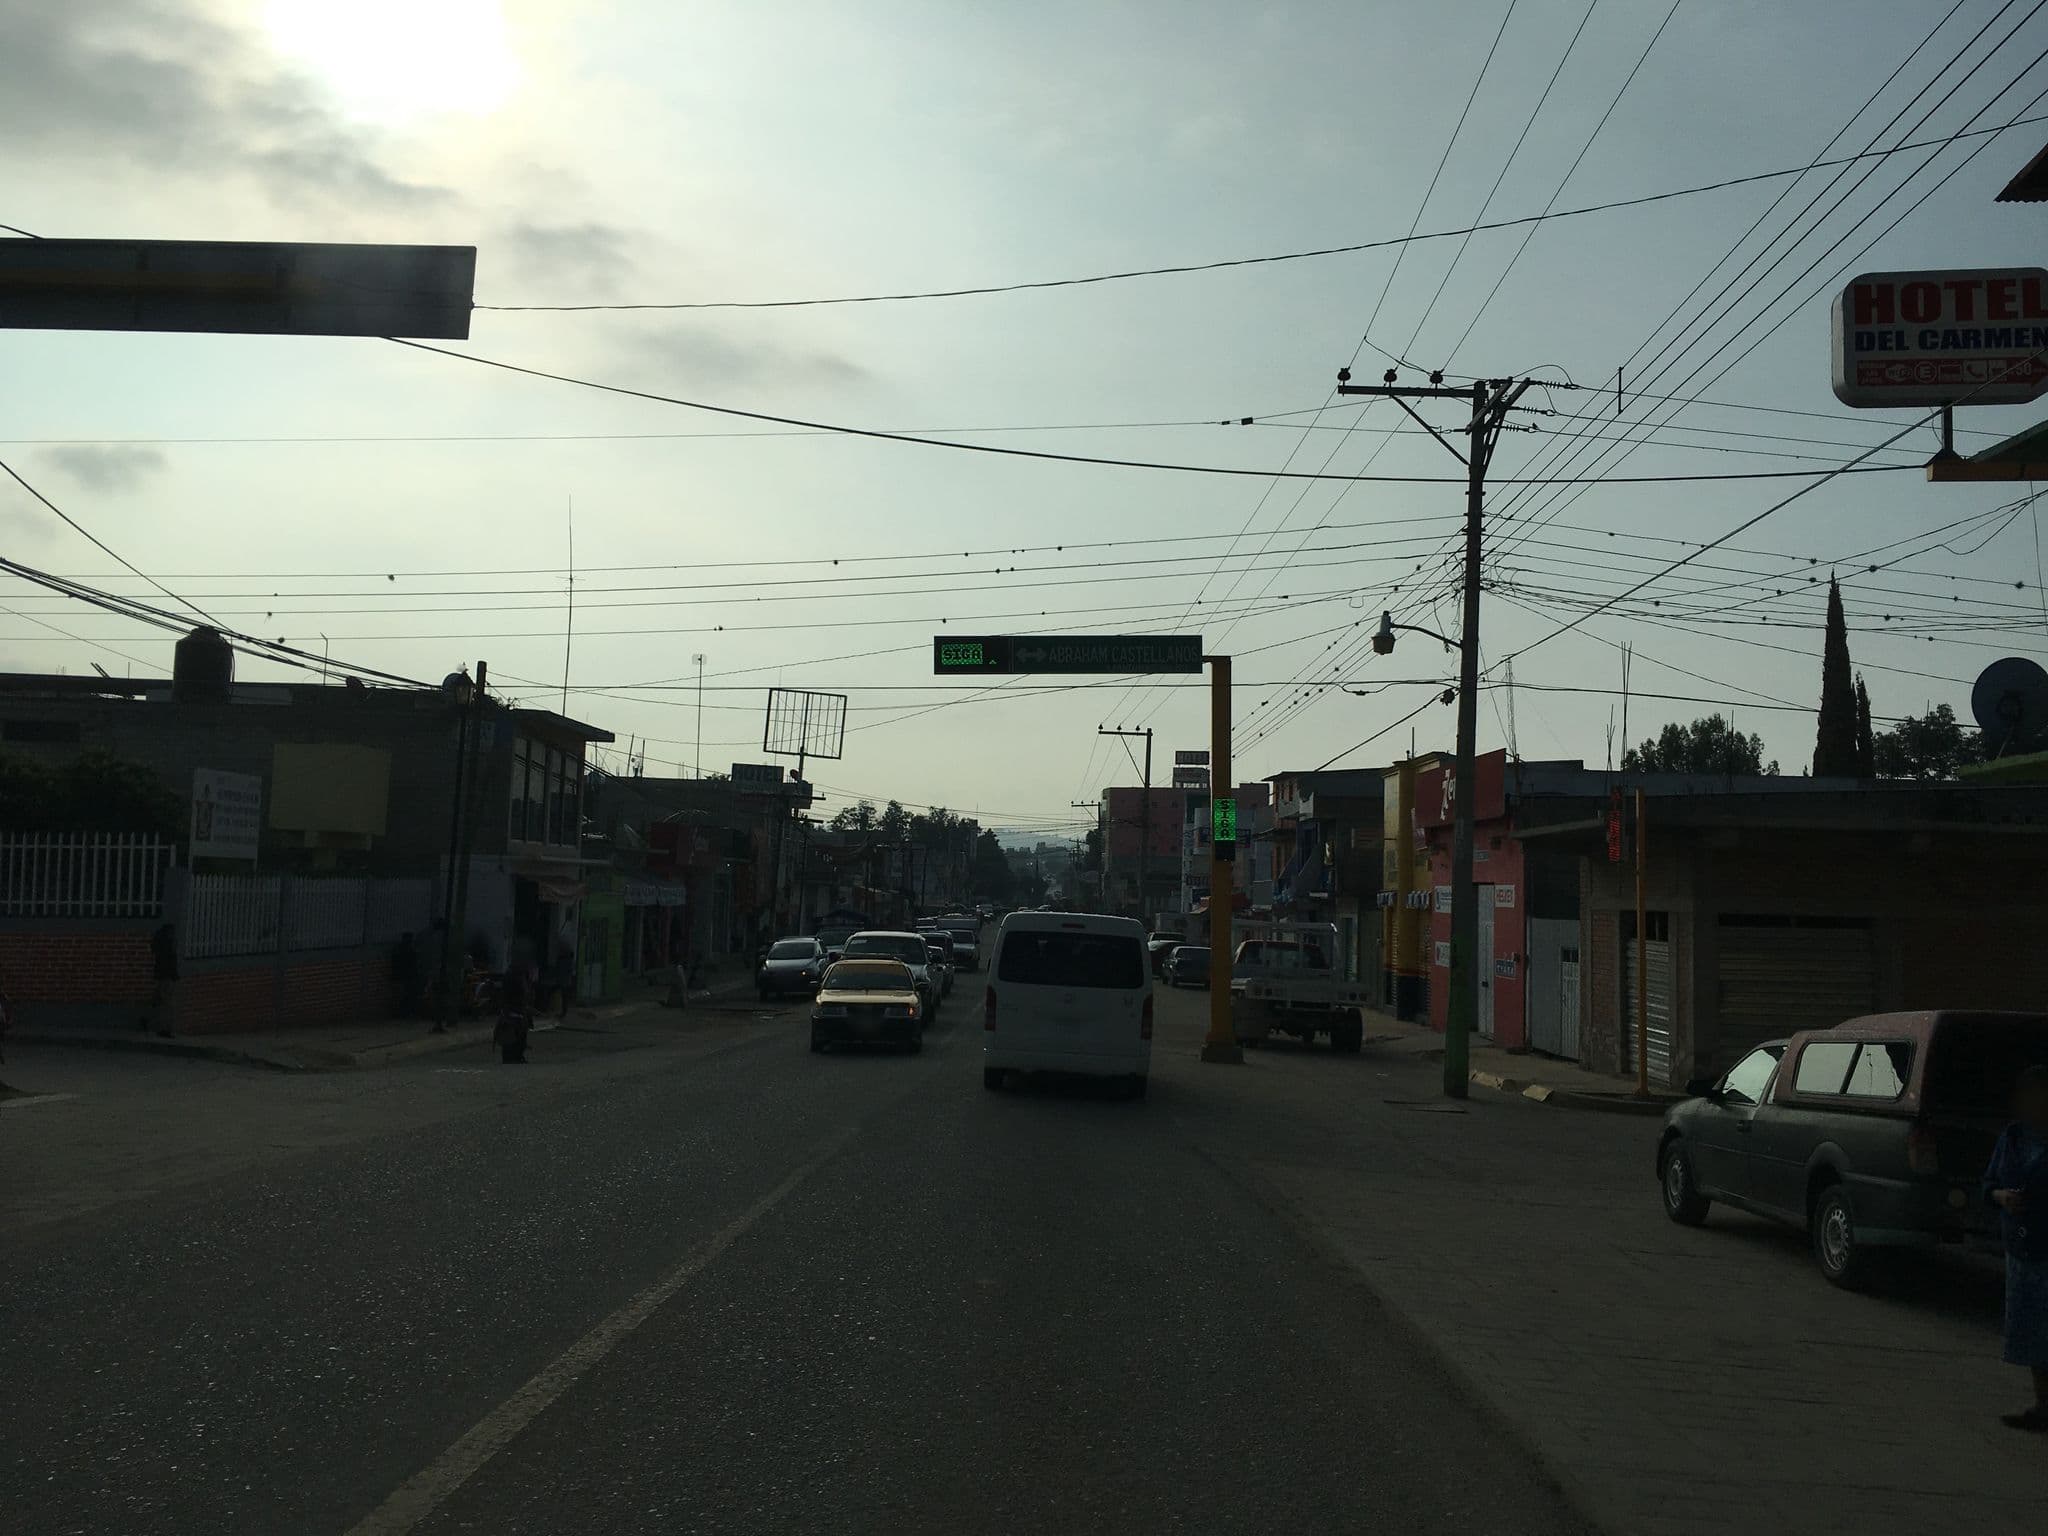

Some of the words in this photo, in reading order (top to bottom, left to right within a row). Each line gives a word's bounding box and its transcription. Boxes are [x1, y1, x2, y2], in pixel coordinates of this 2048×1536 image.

[1855, 279, 2048, 324] HOTEL
[1855, 329, 1910, 352] DEL
[1918, 326, 2048, 351] CARMEN
[1048, 647, 1108, 664] ABRAHAM
[1111, 646, 1200, 664] CASTELLANOS
[1219, 799, 1230, 839] SIGA
